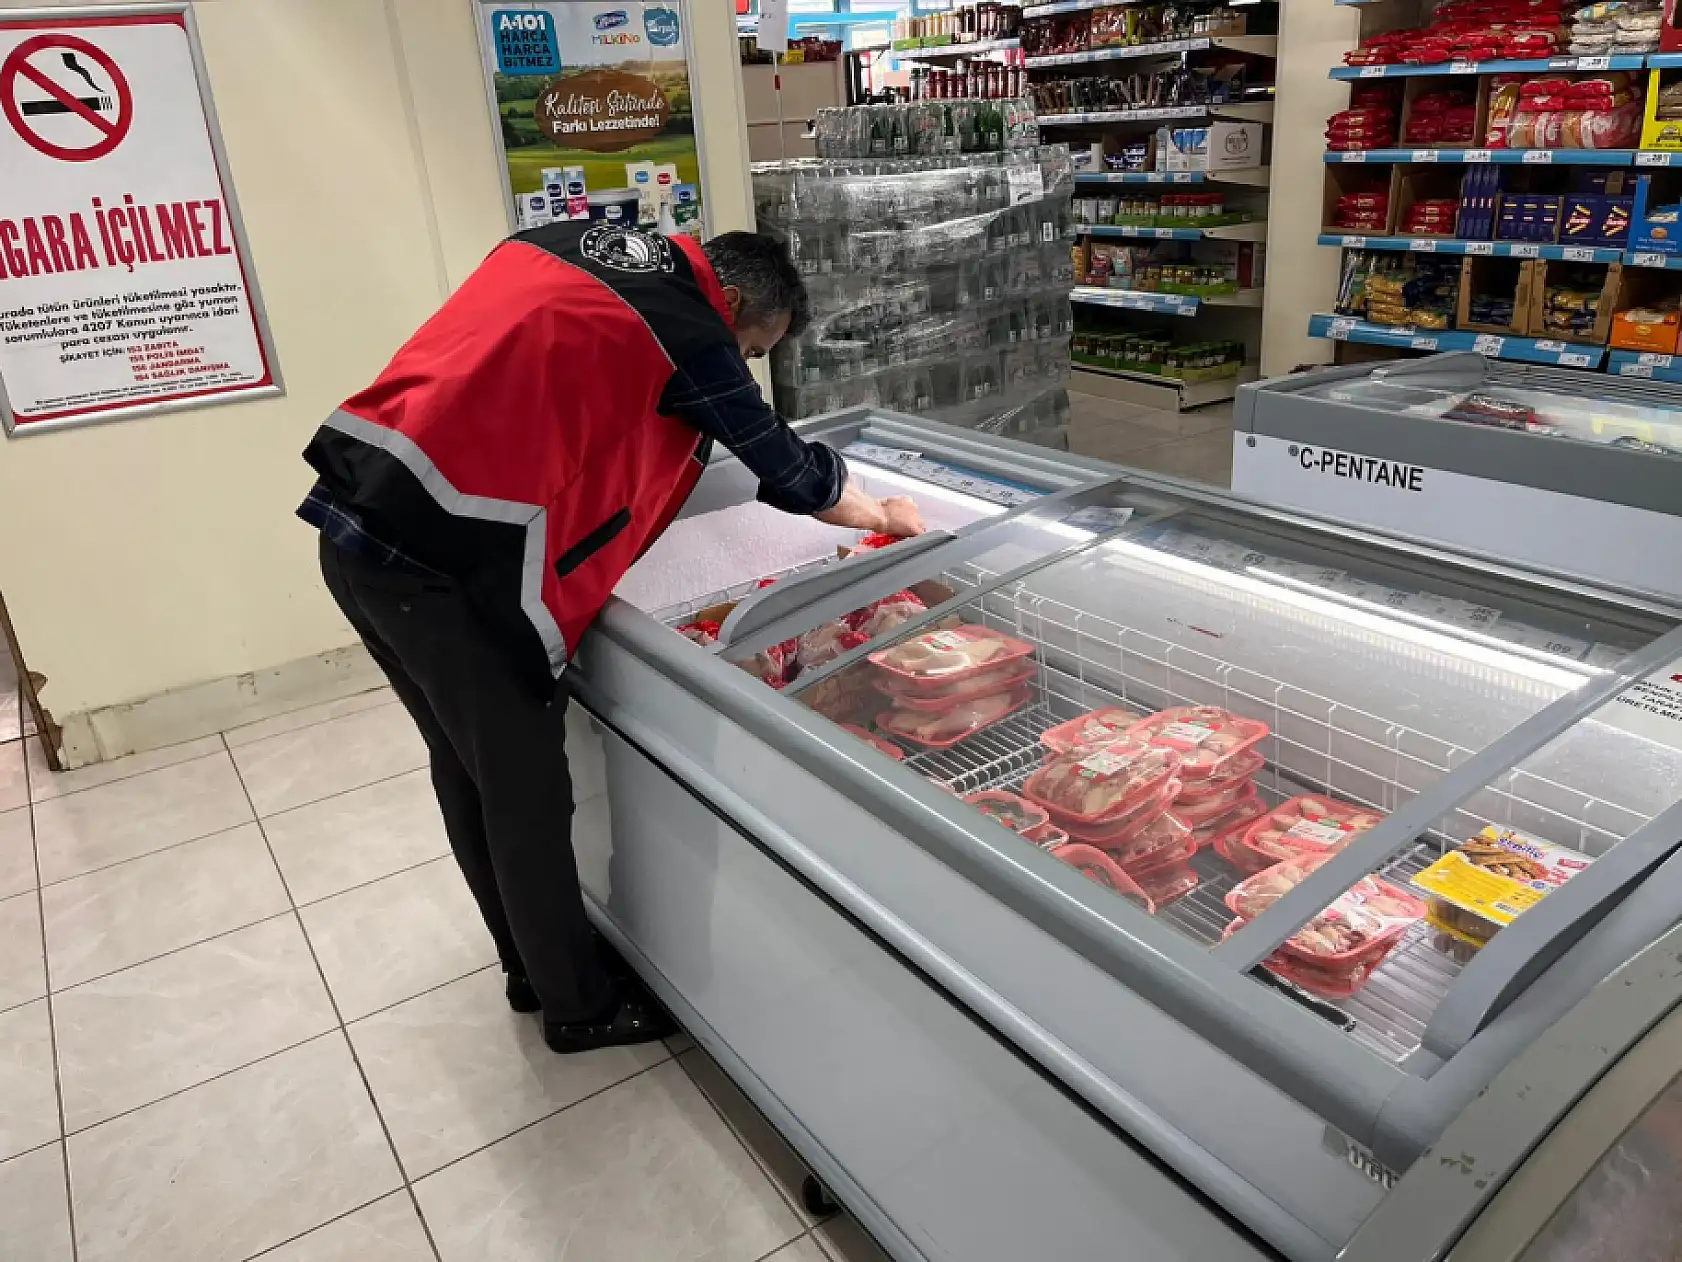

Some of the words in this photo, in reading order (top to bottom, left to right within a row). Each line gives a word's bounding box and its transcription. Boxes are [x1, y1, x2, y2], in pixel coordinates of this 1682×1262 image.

[500, 31, 548, 43] HARCA
[502, 44, 551, 55] HARCA
[553, 119, 587, 134] Farkı
[590, 115, 660, 132] Lezzetinde!
[92, 193, 232, 273] İÇİLMEZ
[37, 301, 69, 314] tütün
[73, 294, 120, 309] ürünleri
[123, 287, 188, 303] tüketilmesi
[74, 314, 88, 322] ve
[92, 302, 170, 319] tüketilmesine
[174, 299, 195, 311] göz
[199, 295, 238, 309] yuman
[5, 327, 78, 344] sorumlulara
[82, 320, 112, 332] 4207
[116, 316, 156, 329] Kanun
[61, 337, 90, 351] para
[1300, 446, 1424, 492] C-PENTANE
